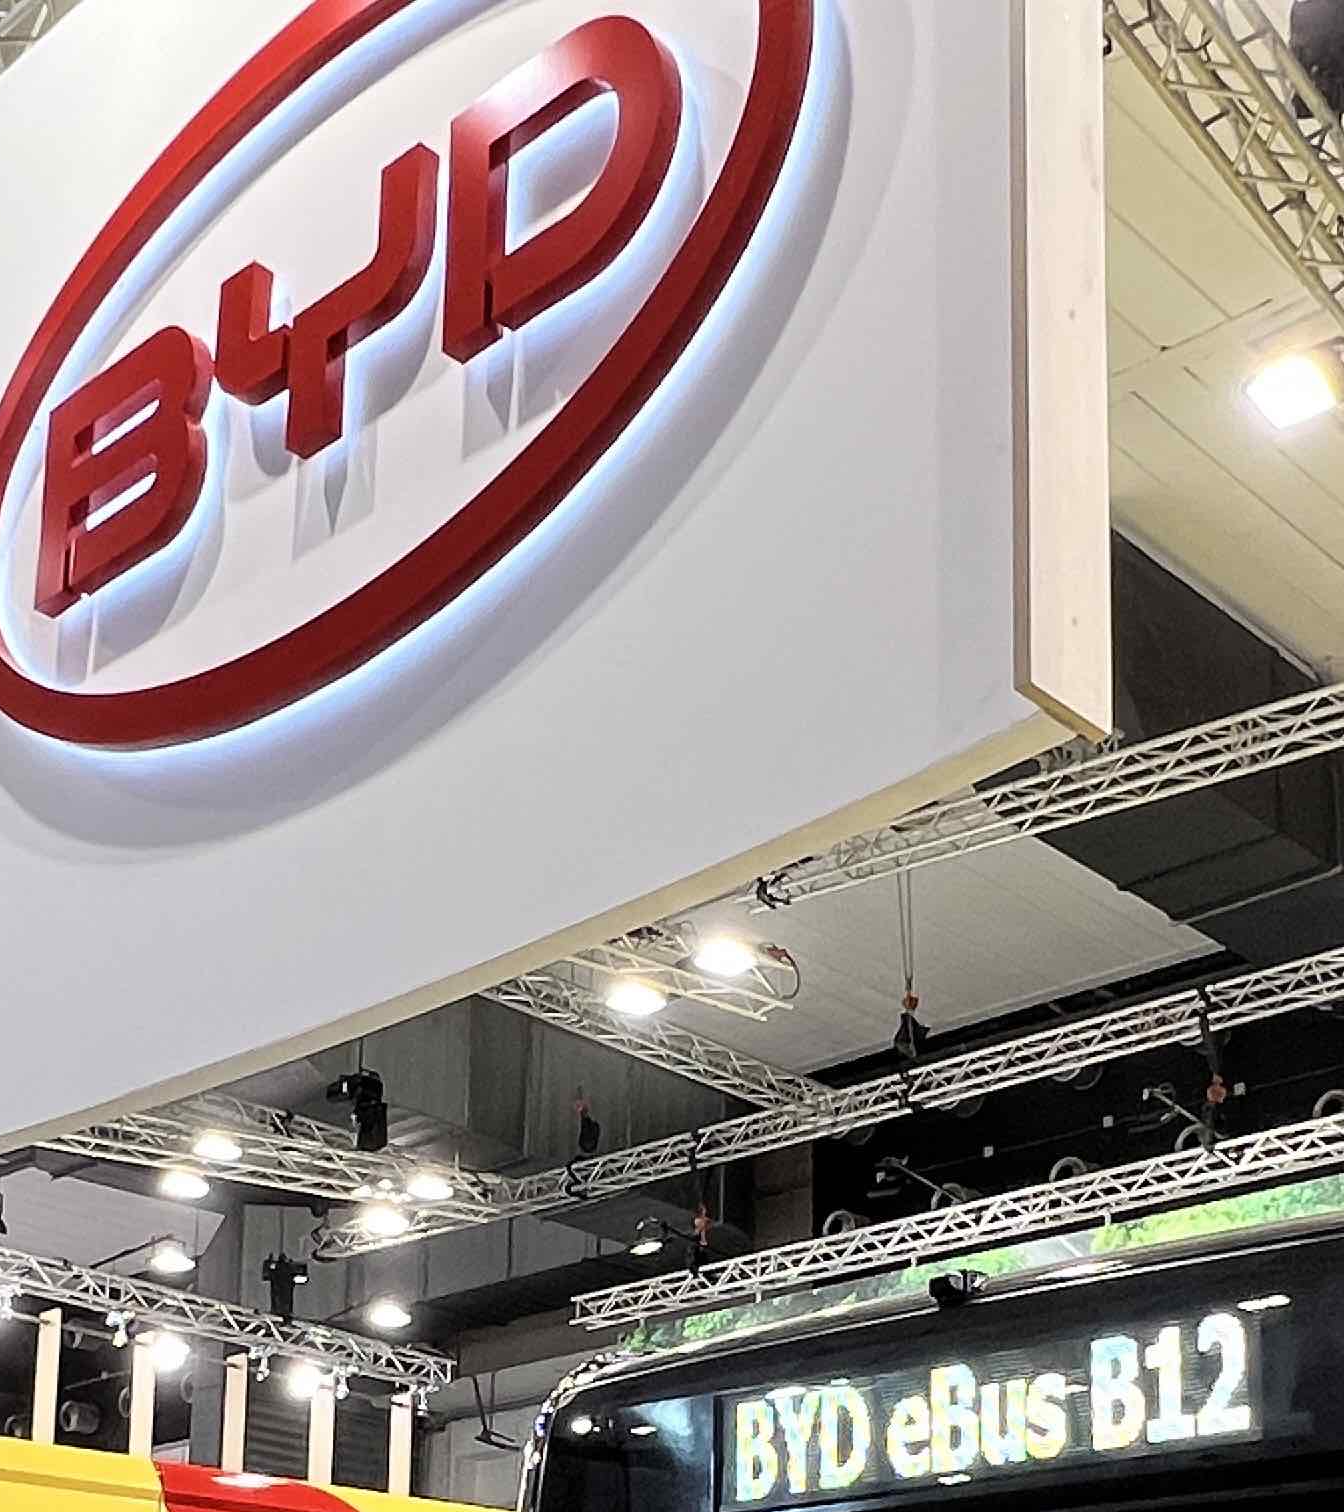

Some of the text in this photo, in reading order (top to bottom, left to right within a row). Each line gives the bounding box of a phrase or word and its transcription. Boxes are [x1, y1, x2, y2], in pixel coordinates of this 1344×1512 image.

[34, 14, 683, 618] BYD
[736, 1312, 1251, 1502] BYD eBus B12
